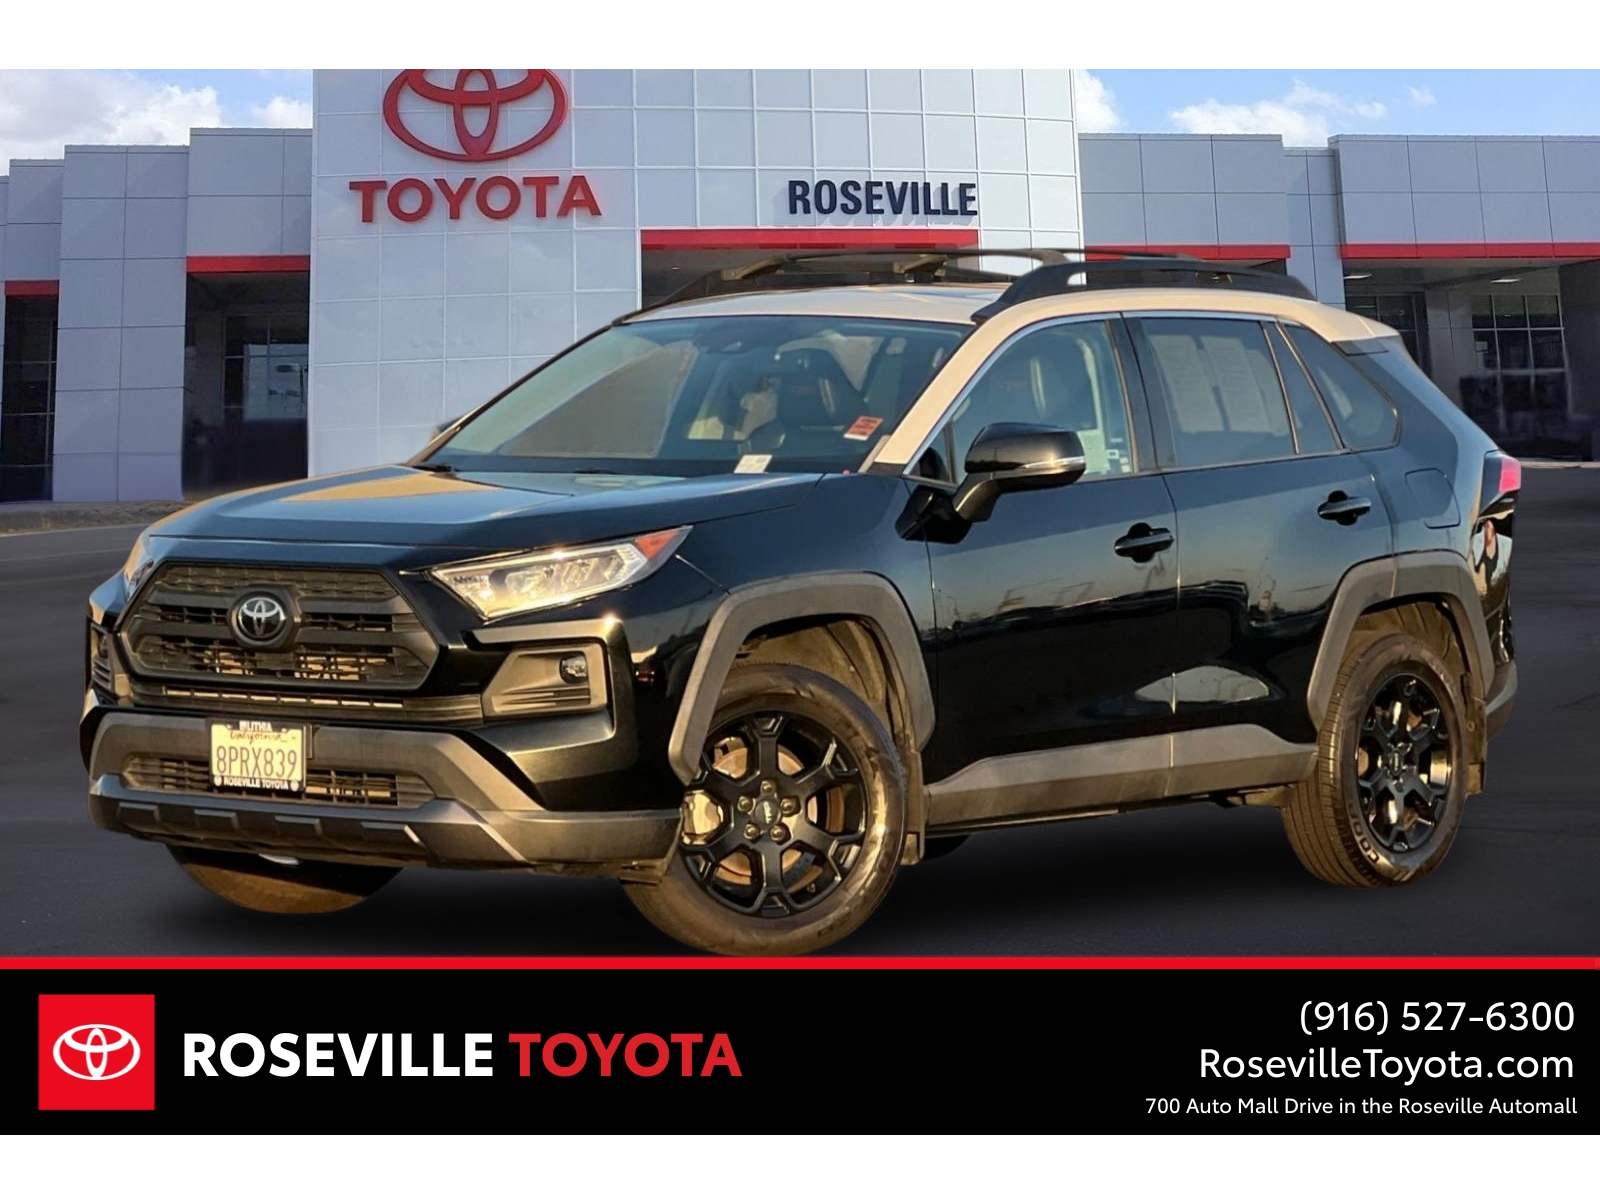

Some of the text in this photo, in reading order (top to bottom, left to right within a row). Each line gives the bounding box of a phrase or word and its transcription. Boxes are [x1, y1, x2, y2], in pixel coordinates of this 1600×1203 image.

[349, 175, 602, 223] TOYOTA
[788, 180, 978, 216] ROSEVILLE
[216, 745, 298, 778] 8PRX839
